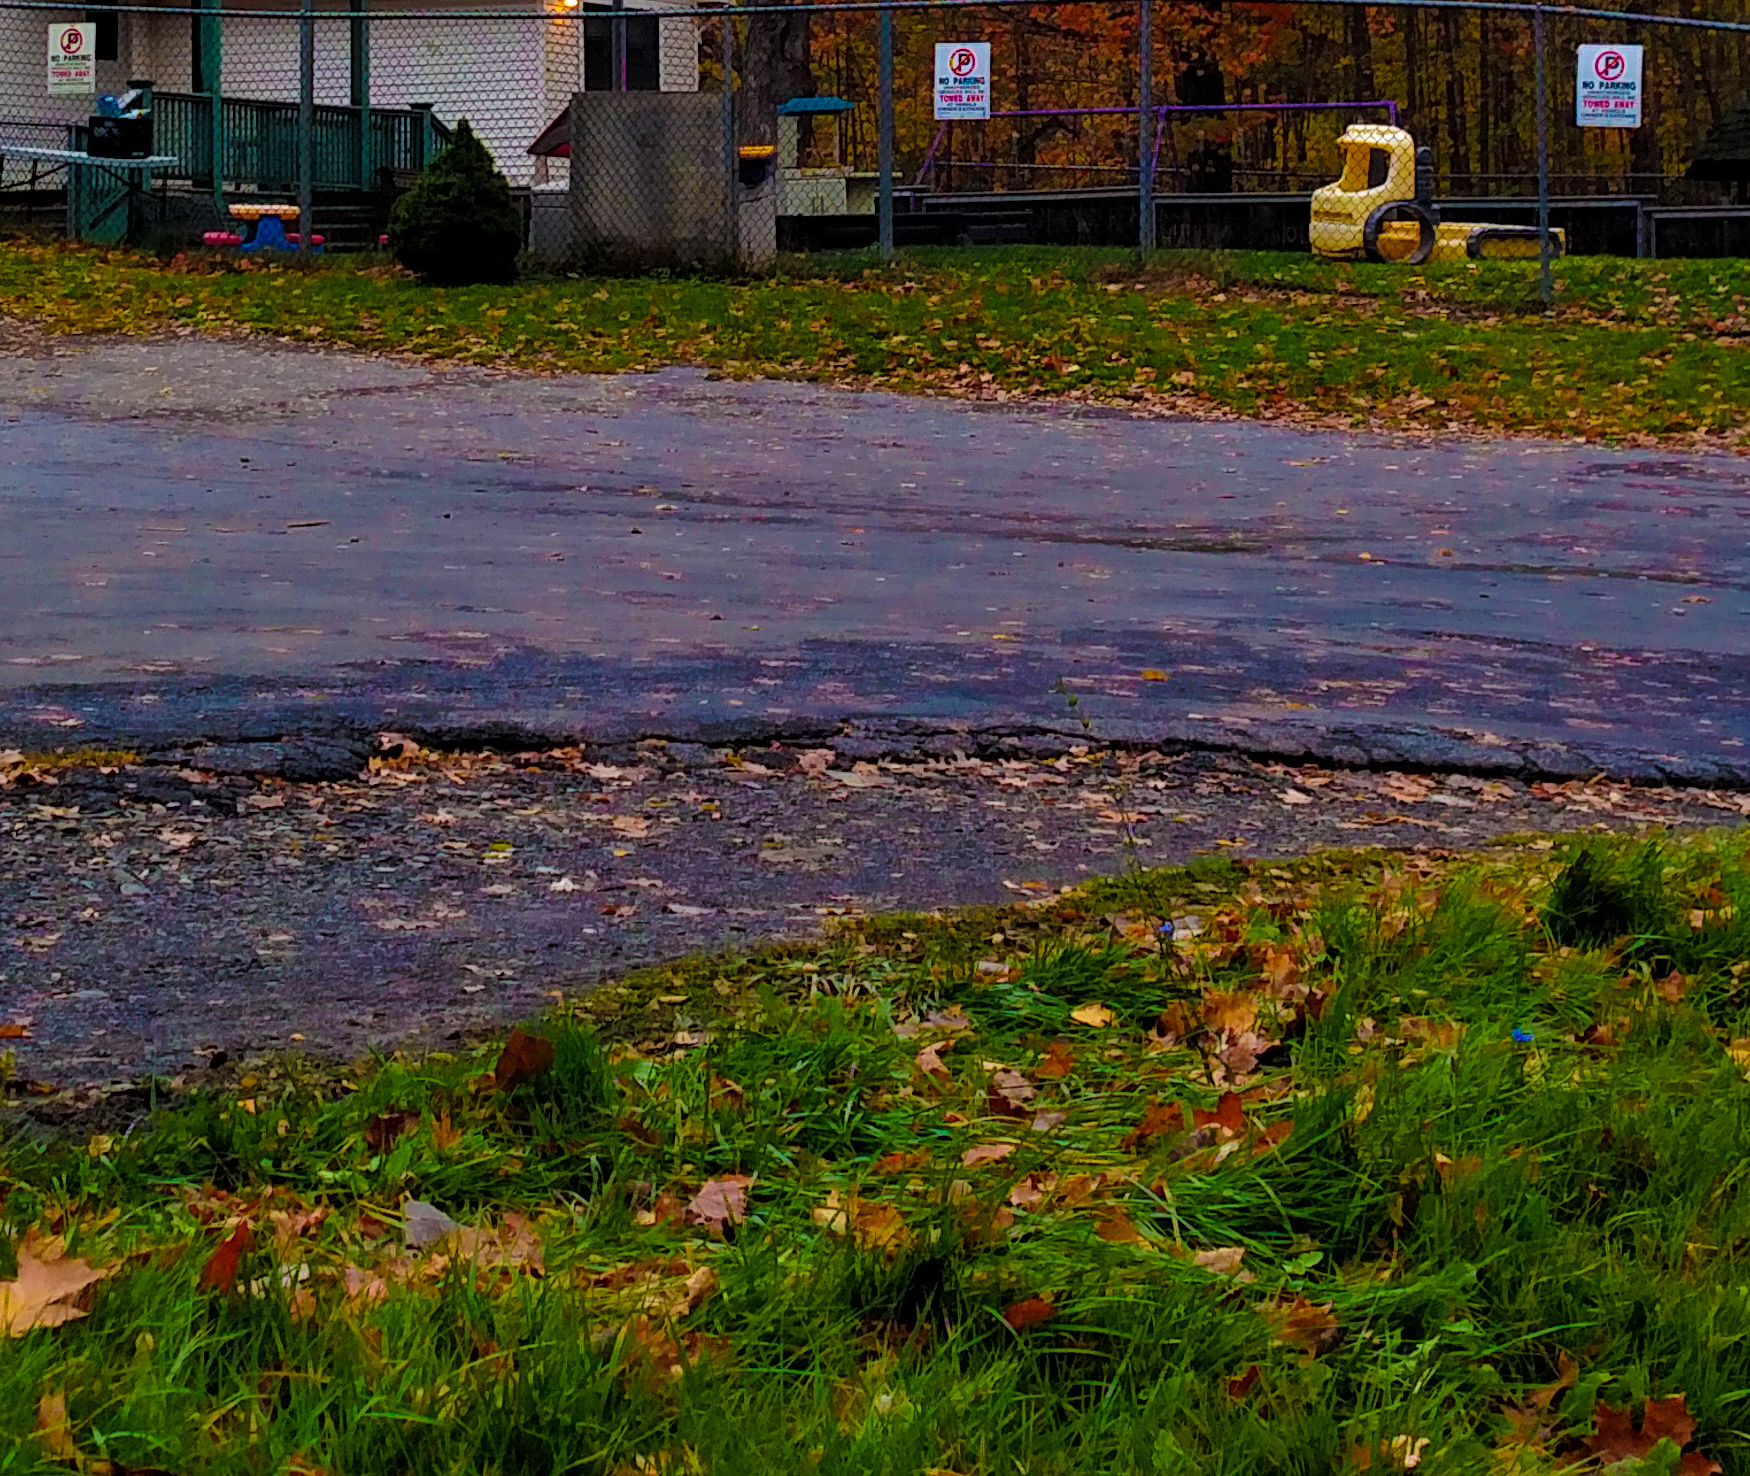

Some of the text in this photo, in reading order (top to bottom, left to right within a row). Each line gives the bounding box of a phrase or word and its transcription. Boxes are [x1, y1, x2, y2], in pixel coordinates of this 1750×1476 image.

[939, 76, 986, 85] NO PARKING
[1582, 81, 1637, 91] NO PARKING
[939, 95, 985, 103] TOWED AWAY
[1583, 100, 1636, 109] TOWED AWAY
